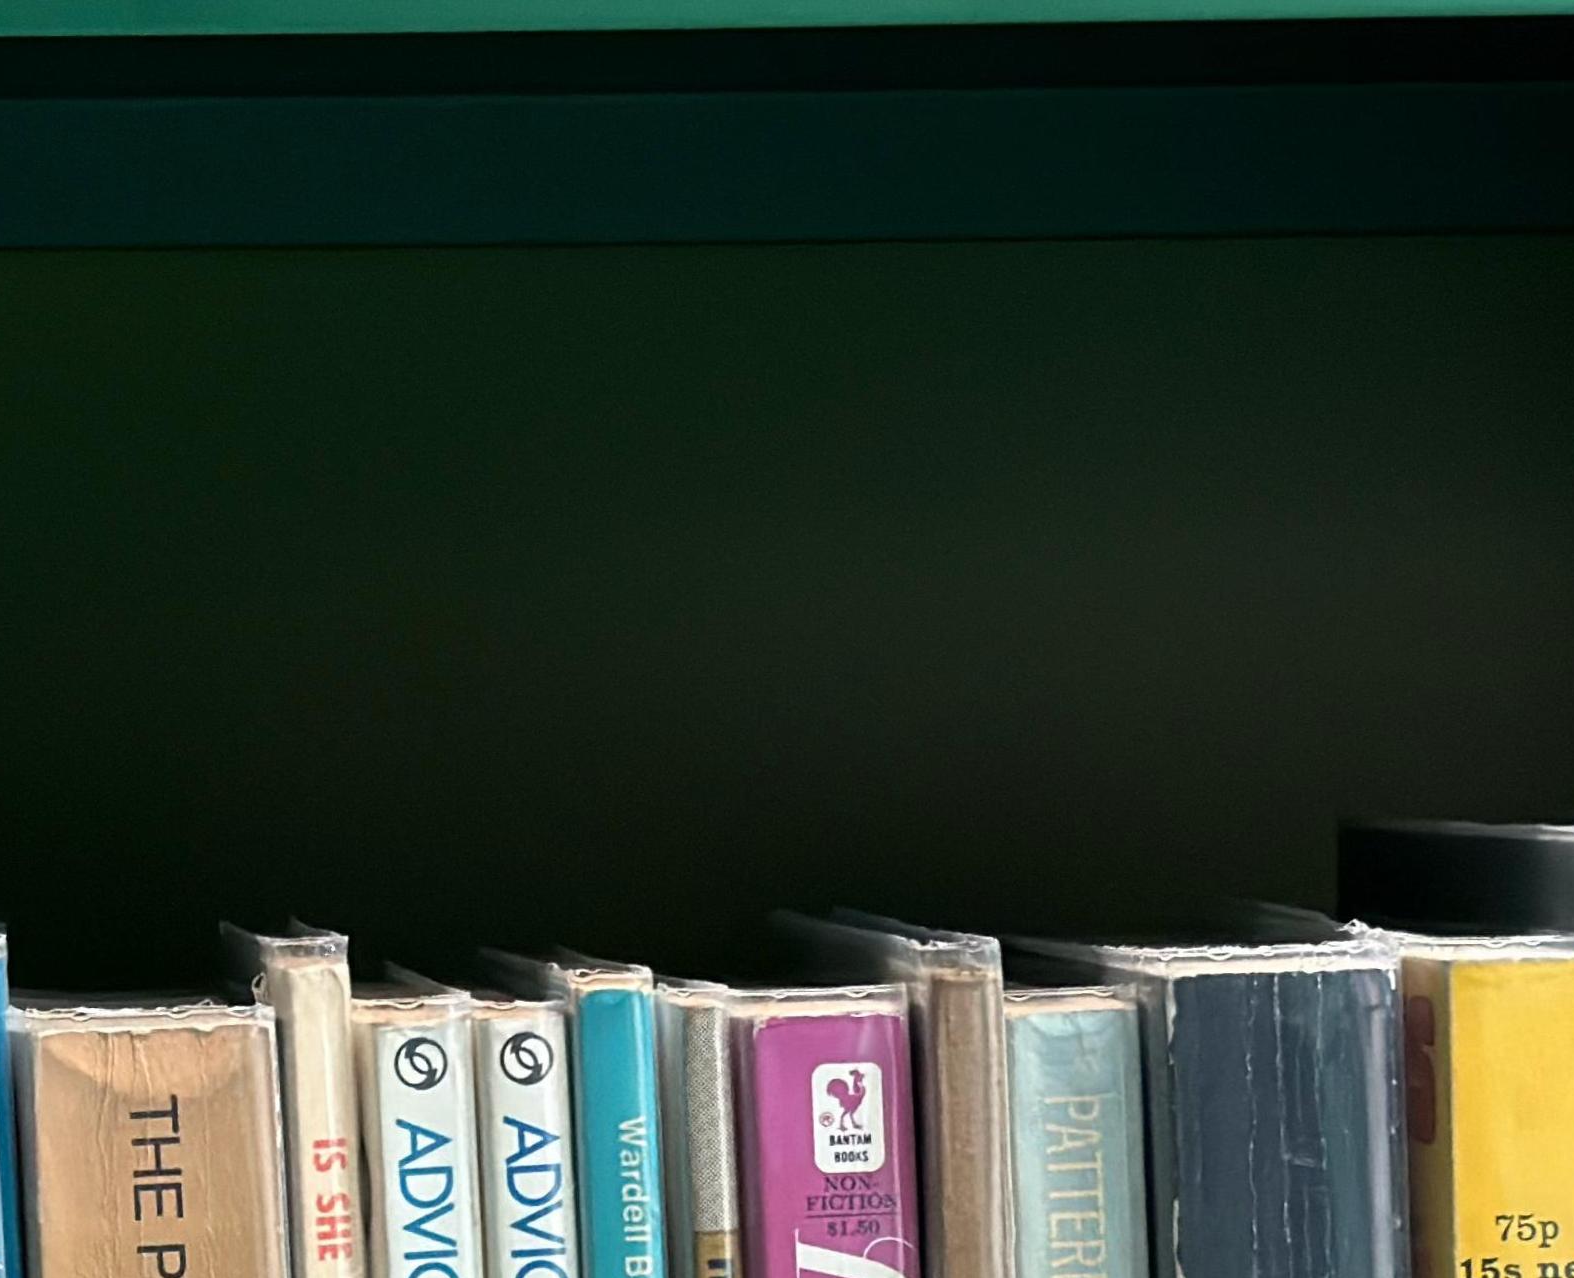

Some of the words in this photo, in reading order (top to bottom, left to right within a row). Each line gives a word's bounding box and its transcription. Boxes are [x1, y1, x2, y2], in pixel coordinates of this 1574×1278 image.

[829, 1133, 873, 1147] BANTAM
[129, 1094, 184, 1221] THE
[834, 1151, 868, 1164] BOOKS
[1494, 1213, 1560, 1249] 75p
